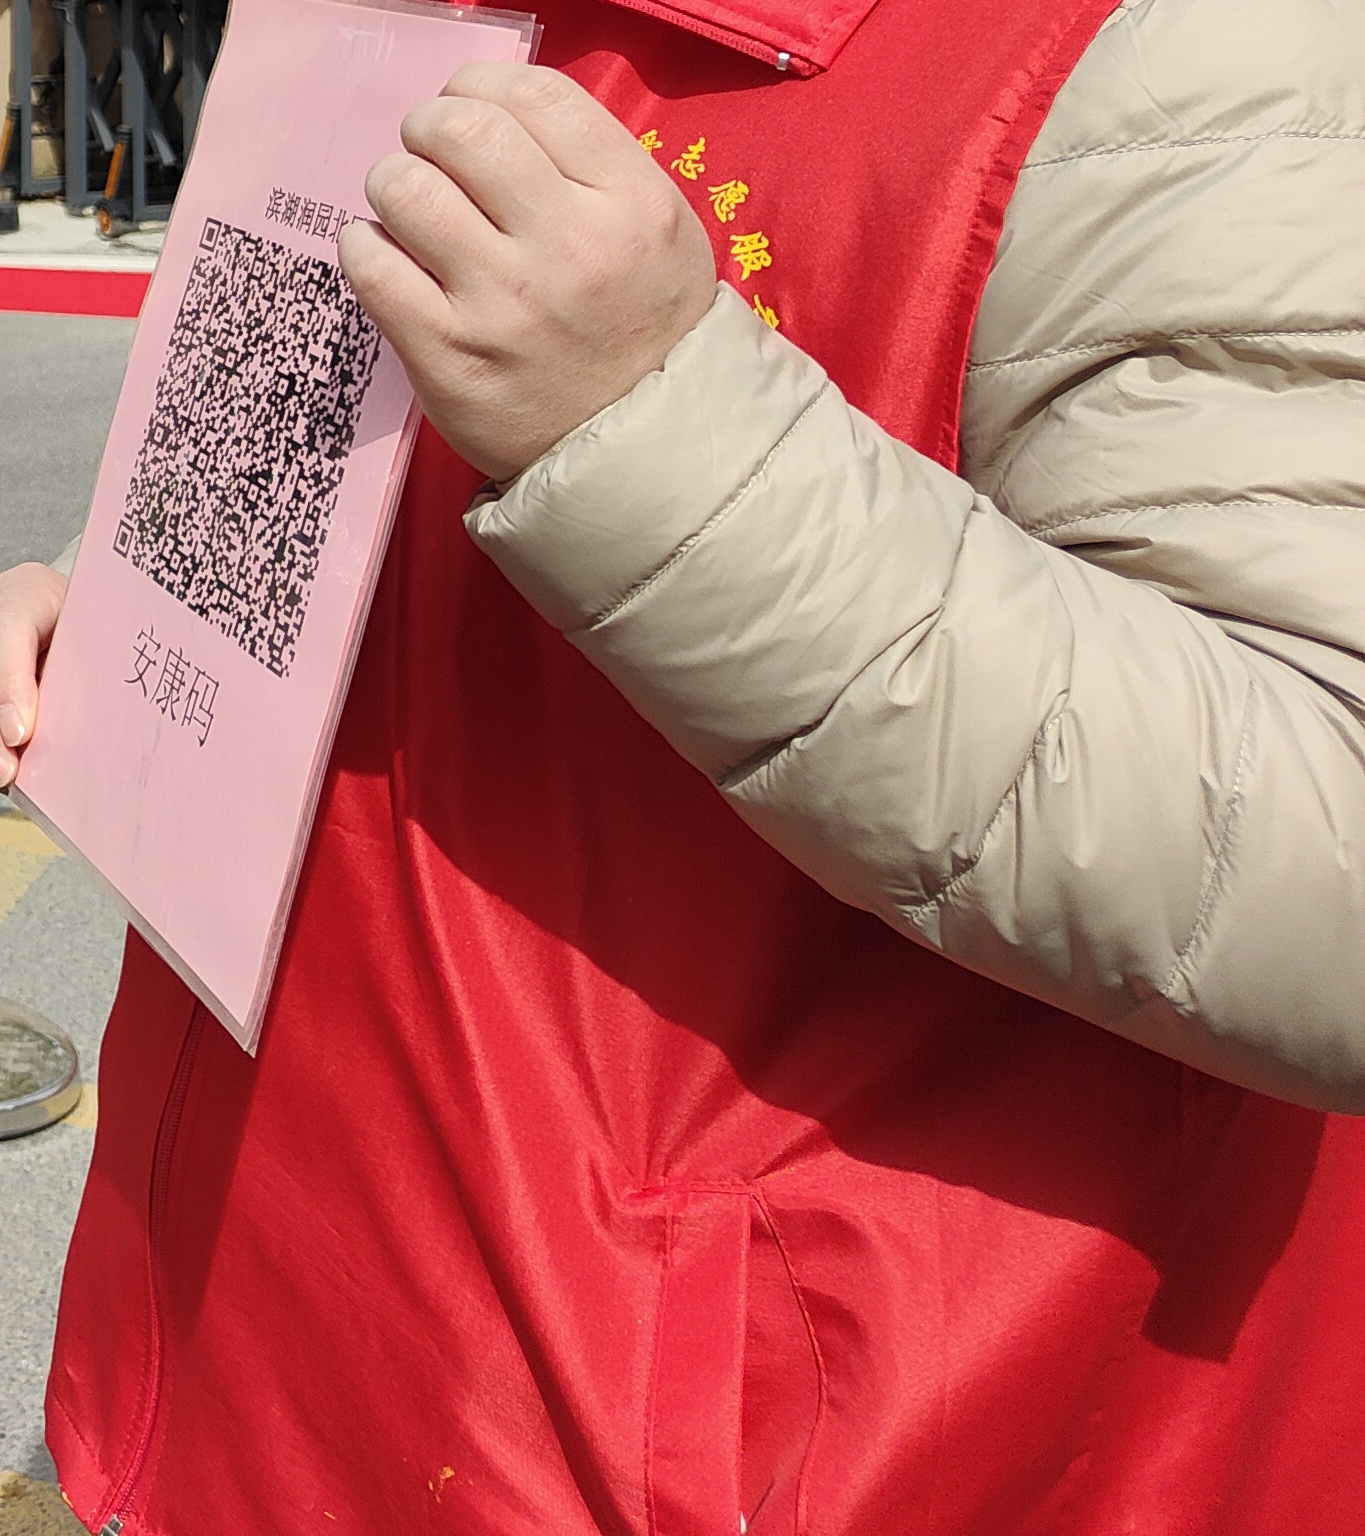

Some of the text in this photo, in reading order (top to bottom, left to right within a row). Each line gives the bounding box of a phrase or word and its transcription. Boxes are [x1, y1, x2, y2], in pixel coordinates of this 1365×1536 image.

[265, 186, 368, 244] 滨湖润园北
[124, 623, 220, 748] 安康码
